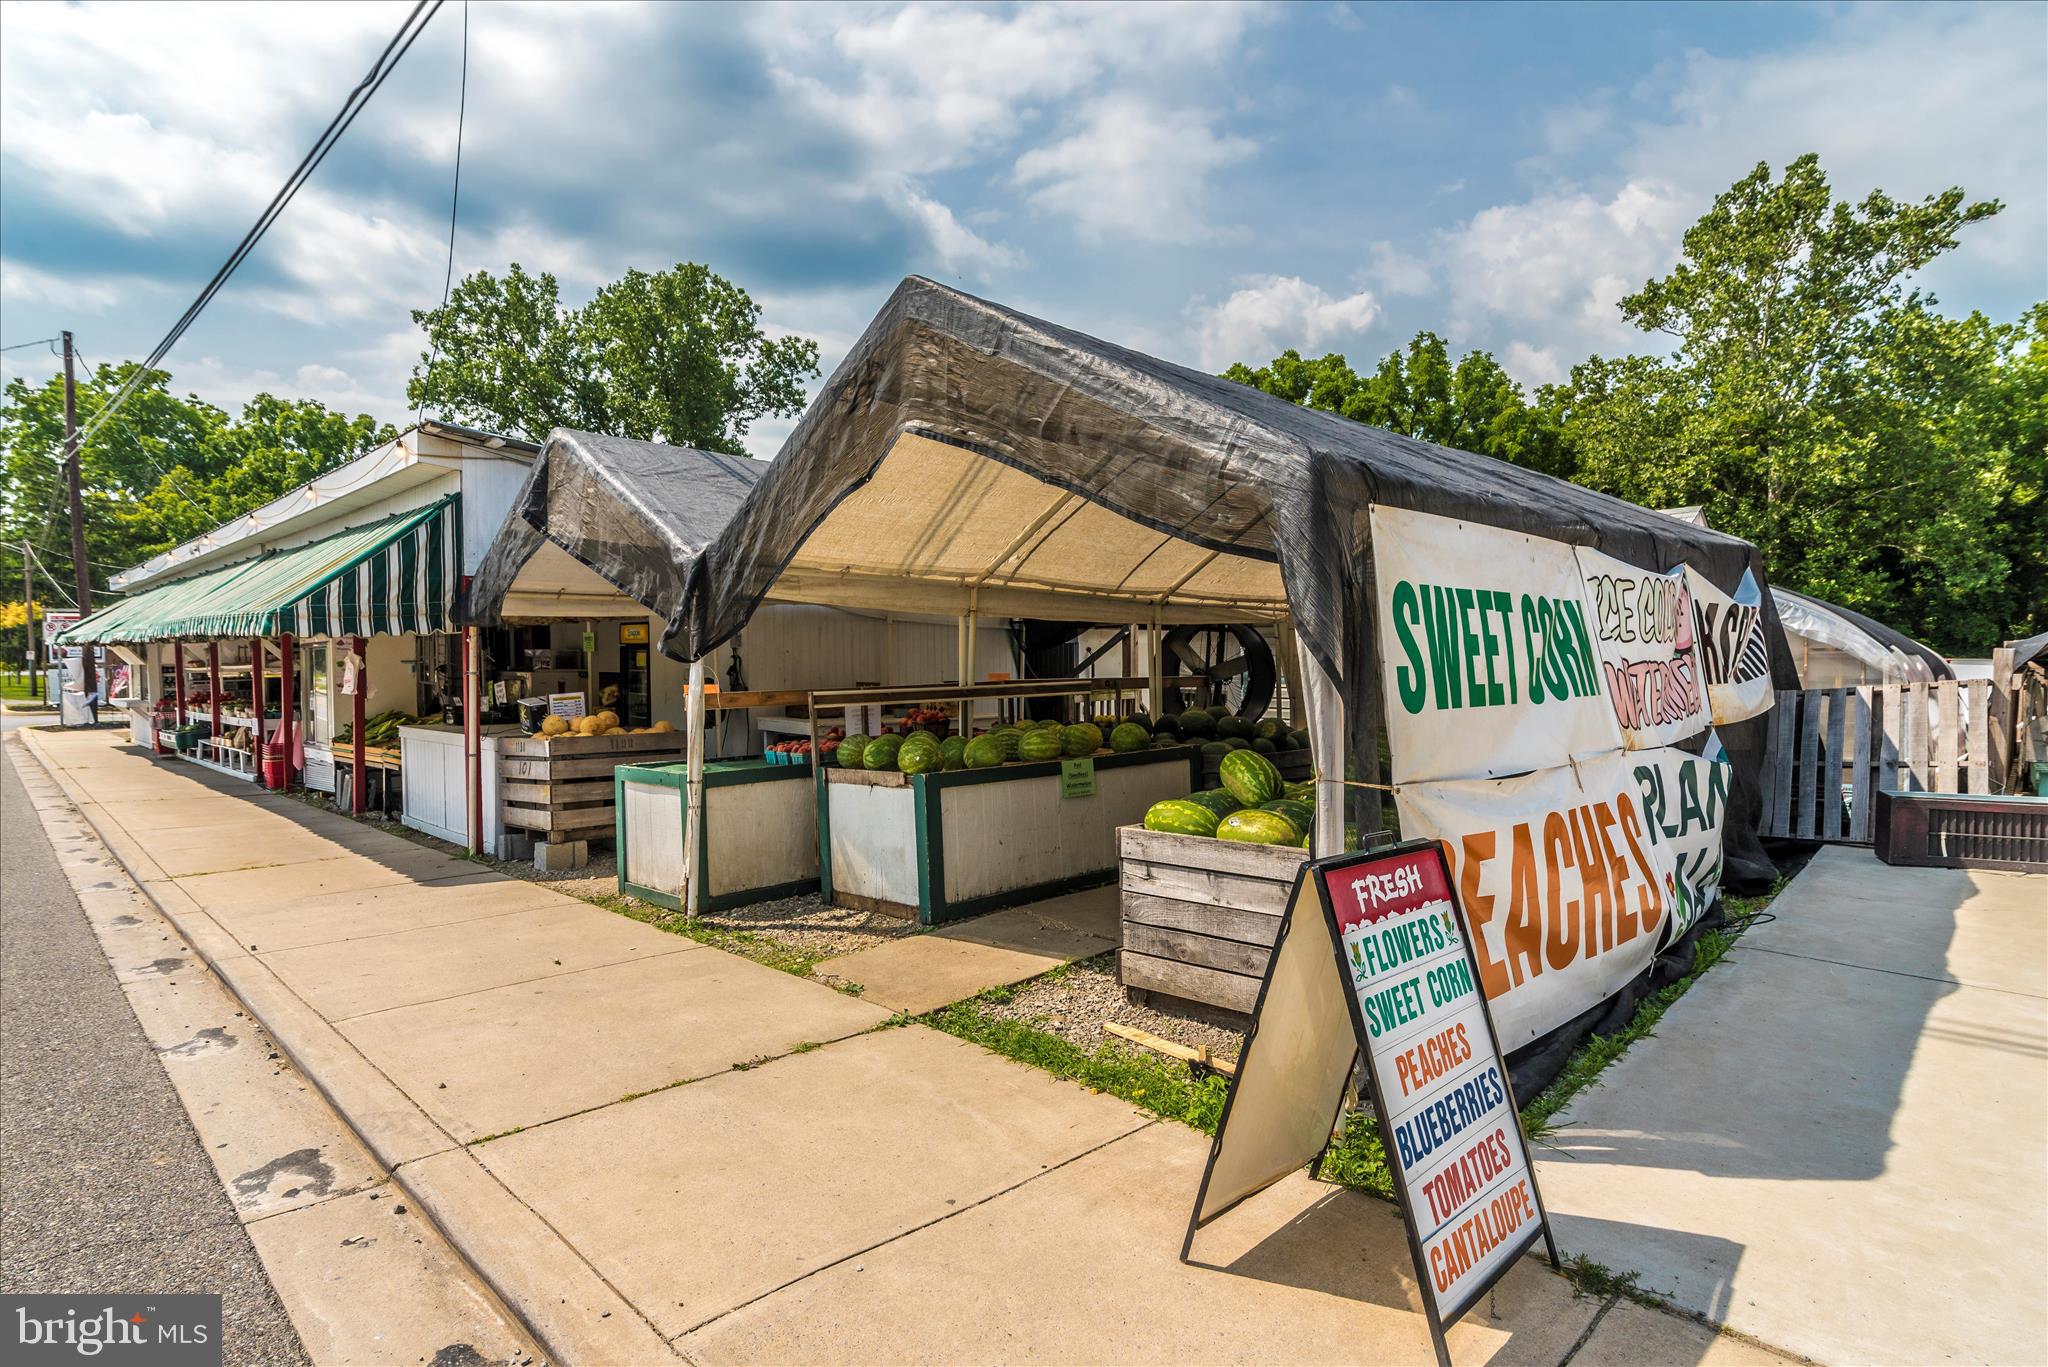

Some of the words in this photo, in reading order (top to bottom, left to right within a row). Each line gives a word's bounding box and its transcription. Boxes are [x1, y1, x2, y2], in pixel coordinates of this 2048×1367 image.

[1392, 580, 1518, 714] SWEET
[1521, 593, 1601, 705] CORN
[1588, 574, 1636, 643] ICE
[1351, 864, 1423, 914] FRESH
[1362, 914, 1445, 976] FLOWERS
[1365, 976, 1421, 1038] SWEET
[1430, 957, 1474, 1008] CORN
[1395, 1021, 1472, 1098] PEACHES
[1394, 1066, 1504, 1171] BLUEBERRIES
[1421, 1127, 1512, 1227] TOMATOES
[1430, 1178, 1535, 1293] CANTALOUPE
